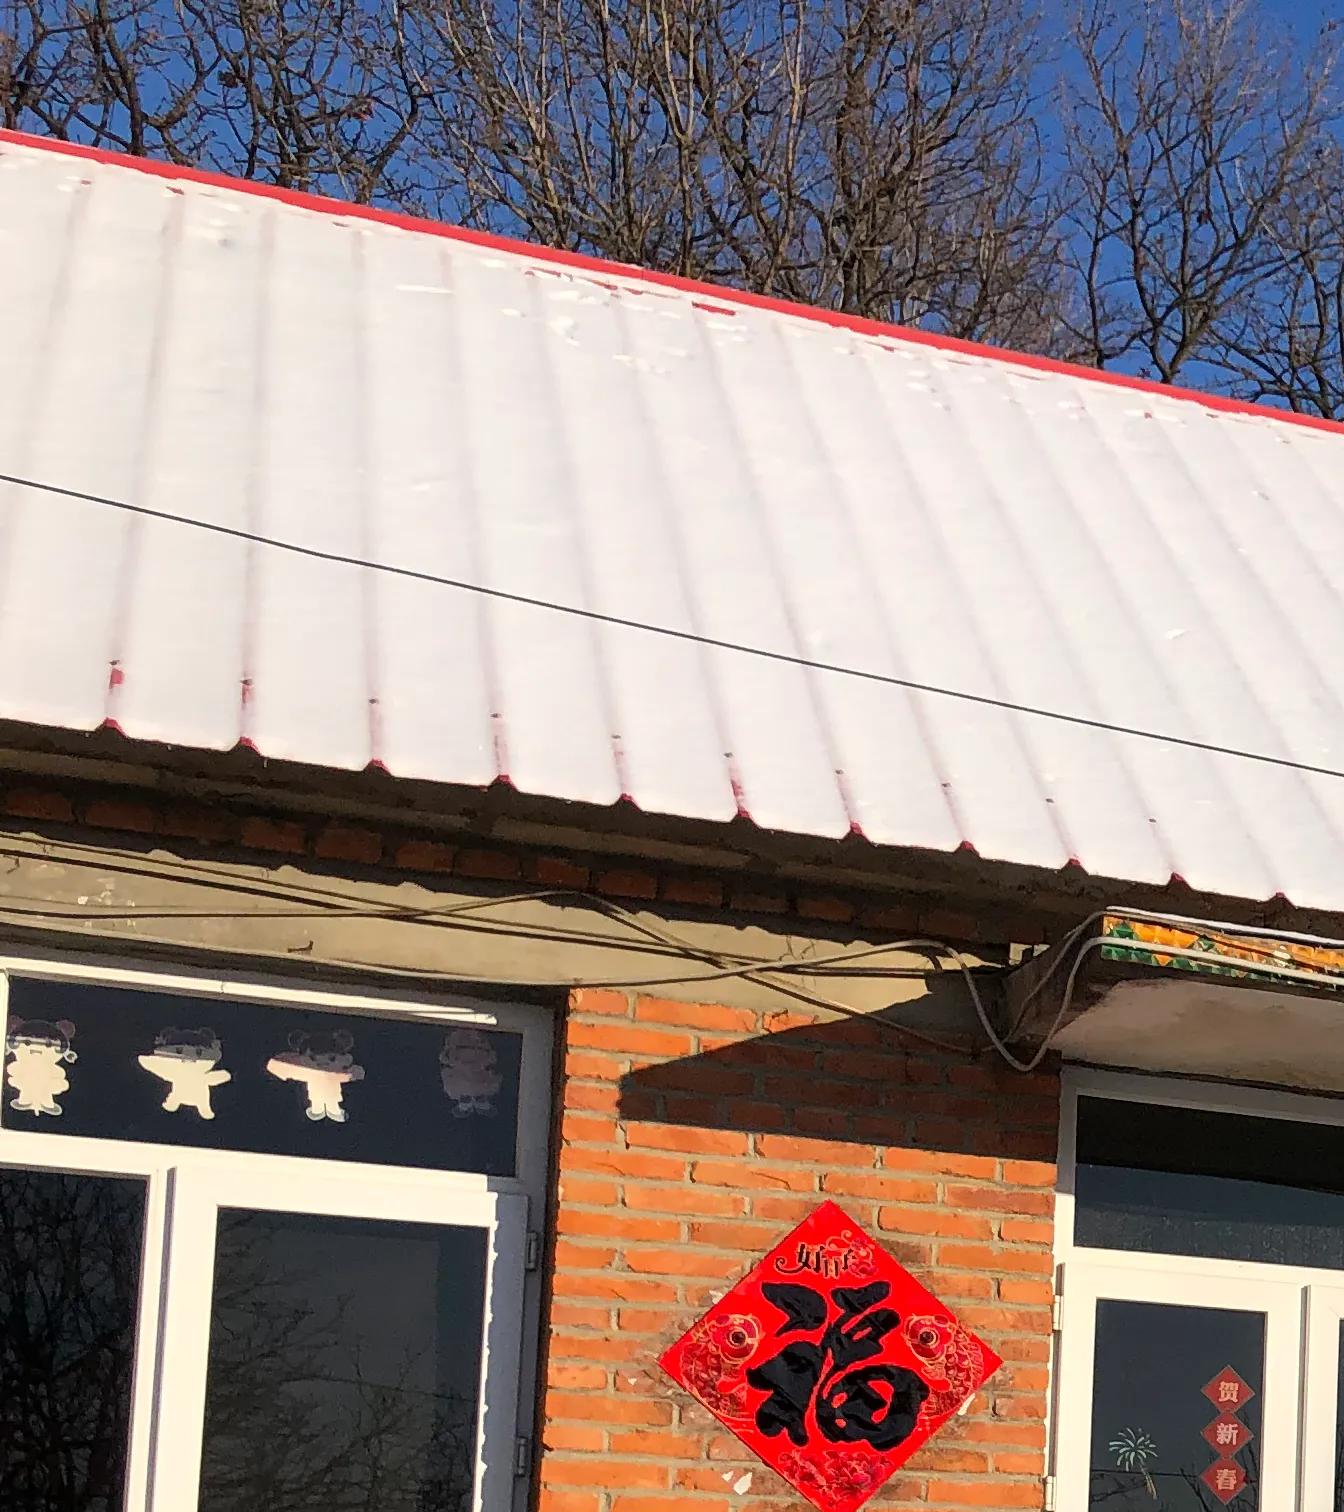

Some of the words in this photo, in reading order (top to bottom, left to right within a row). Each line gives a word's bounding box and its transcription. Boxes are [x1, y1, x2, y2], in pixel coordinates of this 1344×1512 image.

[746, 1281, 930, 1452] 福
[1216, 1381, 1239, 1491] 贺新春
